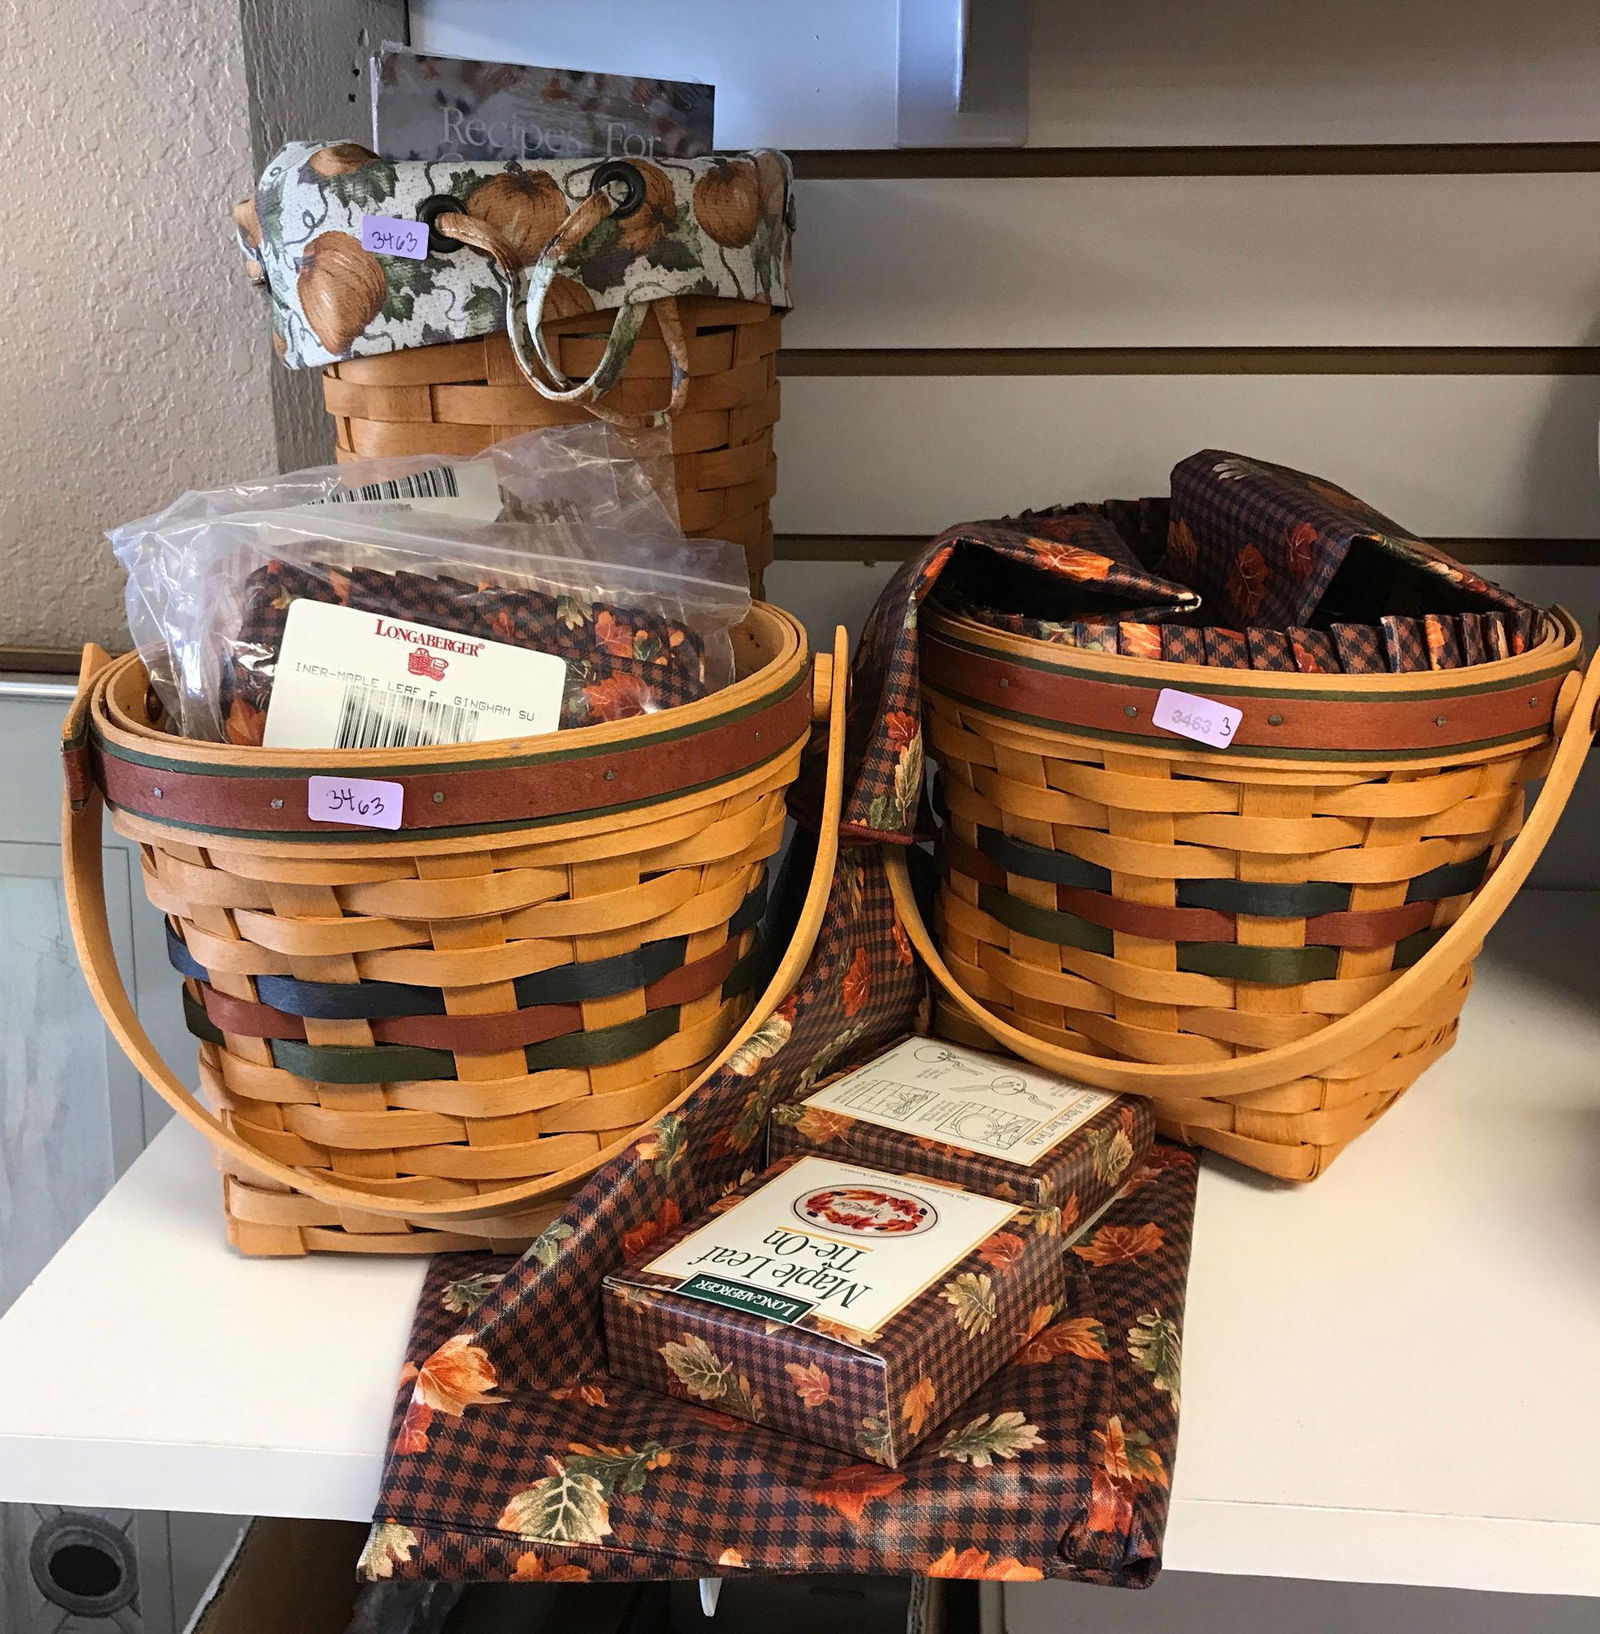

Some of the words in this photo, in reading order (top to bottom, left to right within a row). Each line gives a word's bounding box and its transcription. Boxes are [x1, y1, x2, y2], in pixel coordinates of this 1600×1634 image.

[439, 107, 582, 160] Recipes
[606, 122, 662, 158] For
[371, 231, 418, 253] 3463
[387, 681, 421, 696] LEAF
[453, 696, 511, 716] GINGHAM
[518, 710, 535, 722] SU
[1171, 709, 1213, 735] 3463
[1219, 716, 1232, 736] 3
[326, 788, 385, 816] 3463
[687, 1245, 776, 1279] Leaf
[763, 1230, 868, 1273] Tie-On
[772, 1263, 873, 1308] Maple
